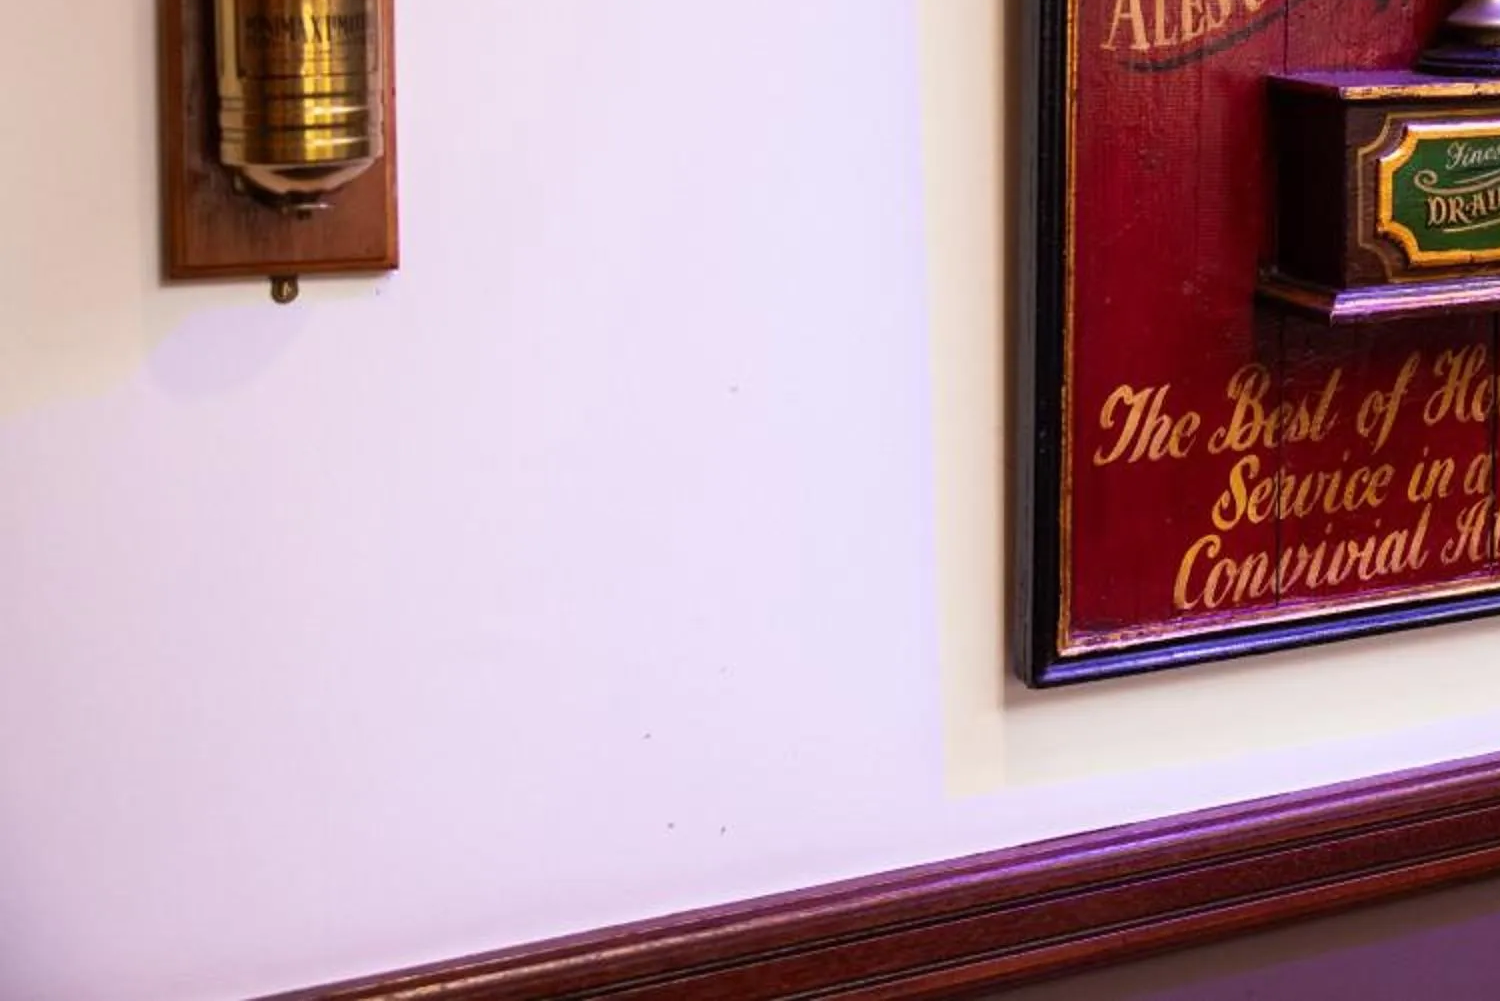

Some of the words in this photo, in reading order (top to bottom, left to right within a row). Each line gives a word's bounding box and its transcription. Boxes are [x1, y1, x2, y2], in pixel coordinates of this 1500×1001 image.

[1093, 382, 1202, 467] The
[1208, 362, 1345, 454] Best
[1356, 351, 1421, 456] of
[1211, 454, 1396, 531] Service
[1407, 445, 1457, 502] in
[1463, 450, 1496, 497] a
[1173, 502, 1433, 611] Convivial
